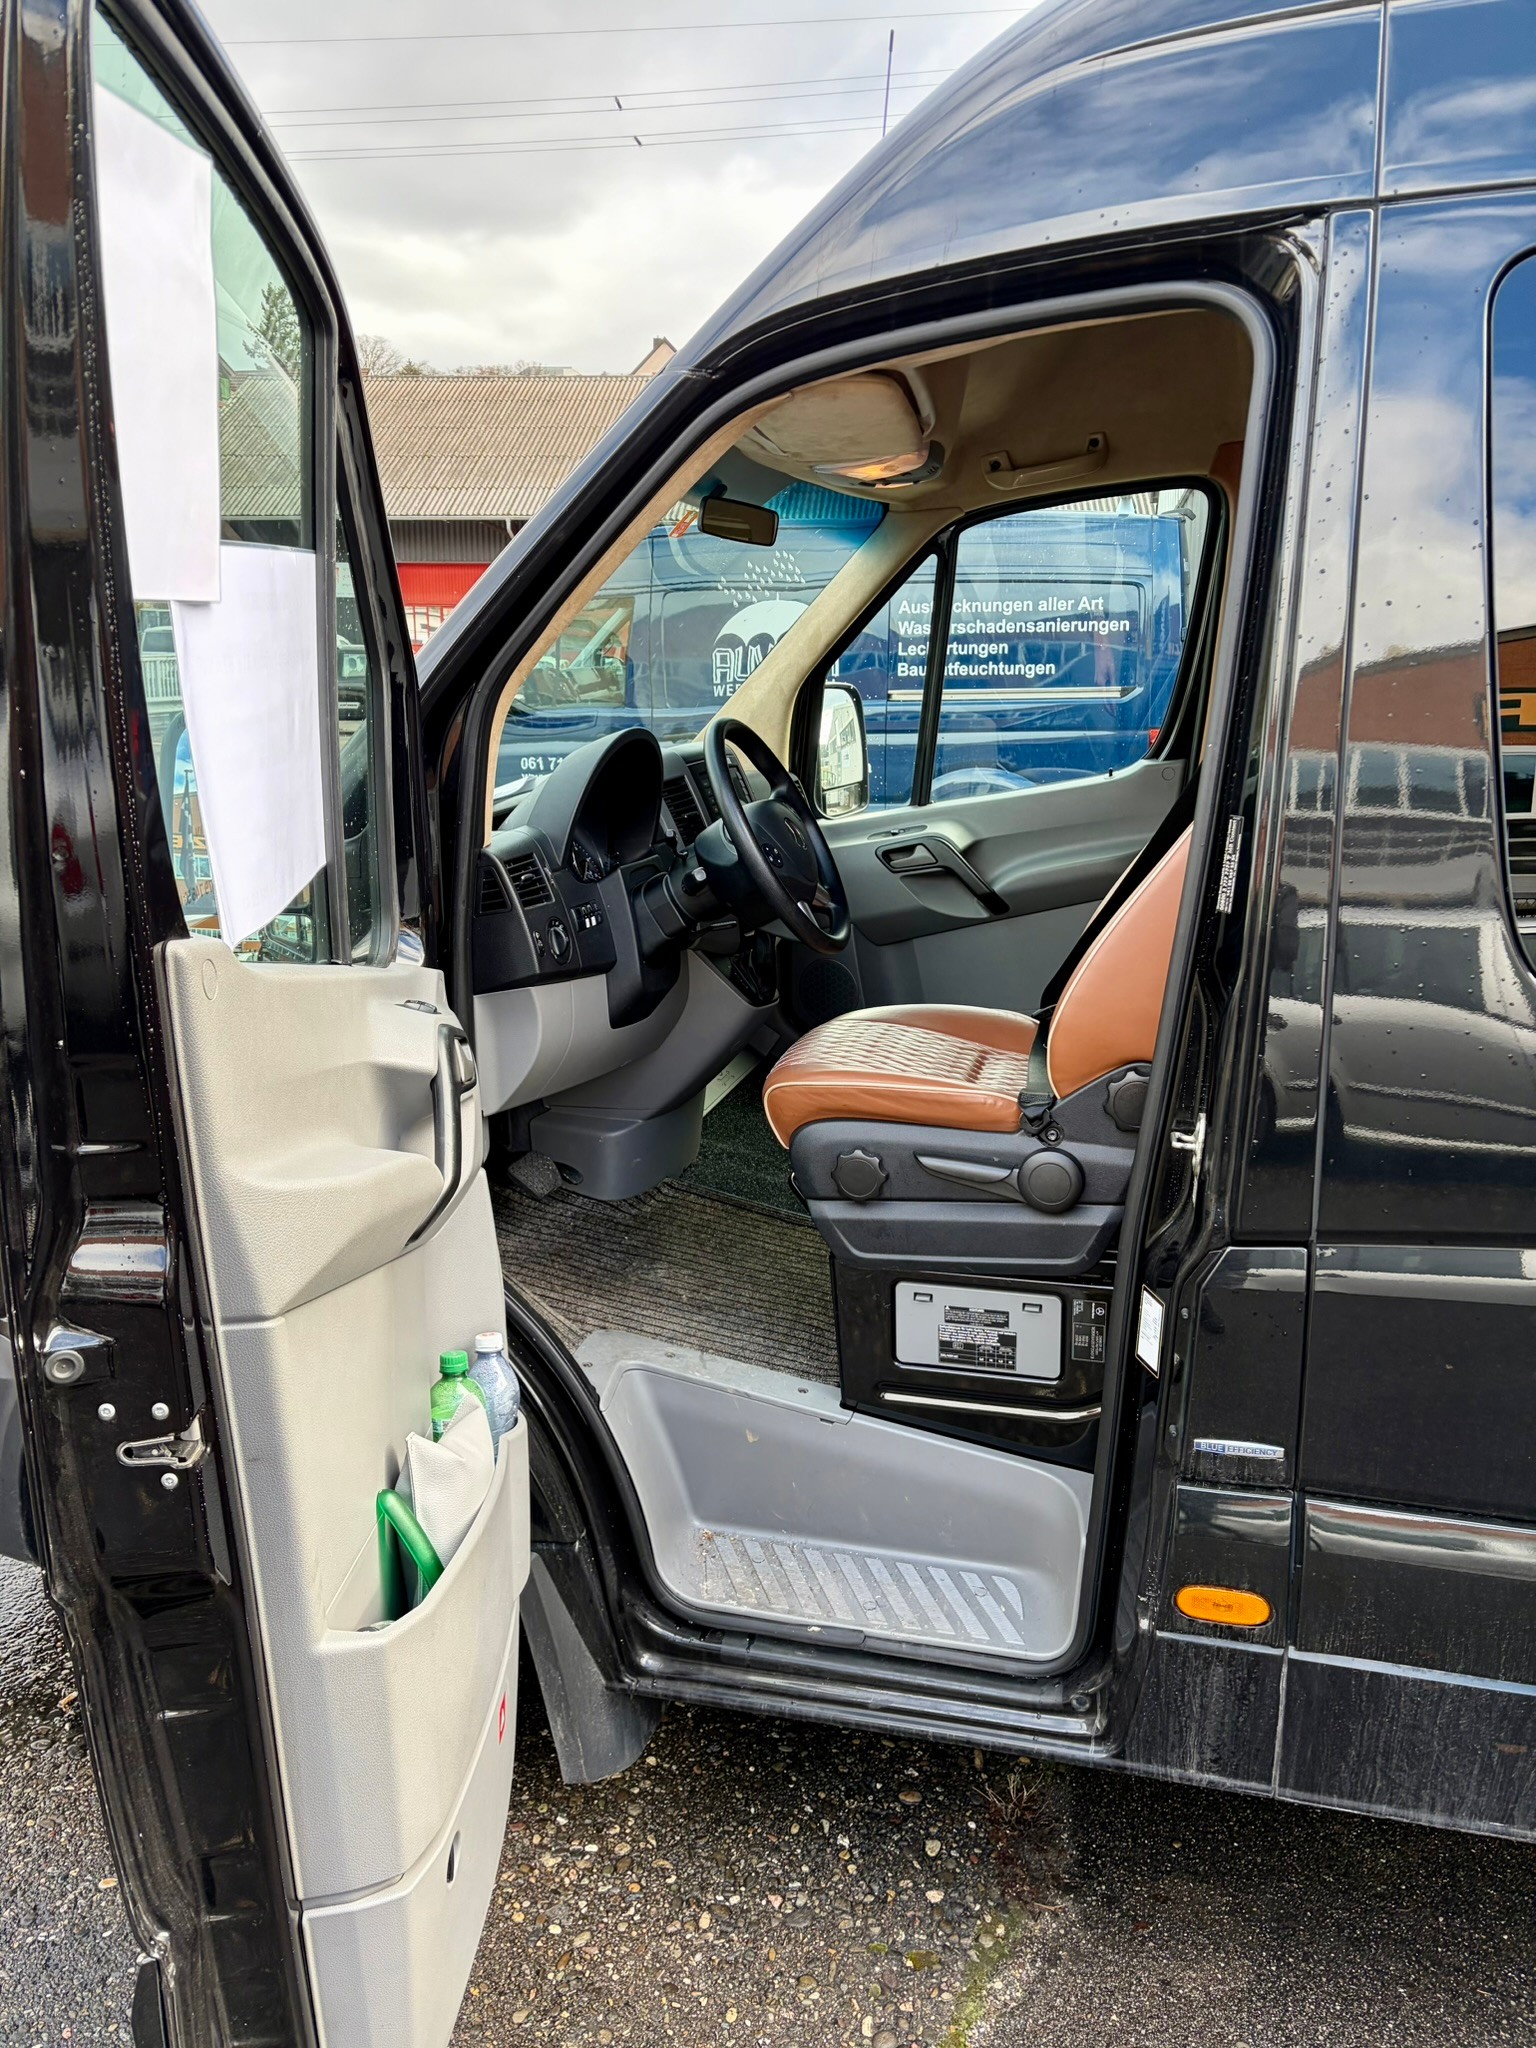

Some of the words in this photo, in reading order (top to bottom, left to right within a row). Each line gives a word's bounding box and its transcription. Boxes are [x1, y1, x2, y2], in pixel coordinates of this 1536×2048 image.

[899, 599, 1033, 616] Auscknungen
[1038, 597, 1074, 611] aller
[1078, 596, 1104, 611] Art
[898, 618, 1130, 635] Wasrschadensanierungen
[898, 641, 1009, 658] Lecrtungen
[897, 661, 1056, 678] Bautfeuchtungen
[520, 756, 544, 770] 061
[1200, 1442, 1223, 1452] BLUE
[1227, 1446, 1278, 1456] EFFICIENCY
